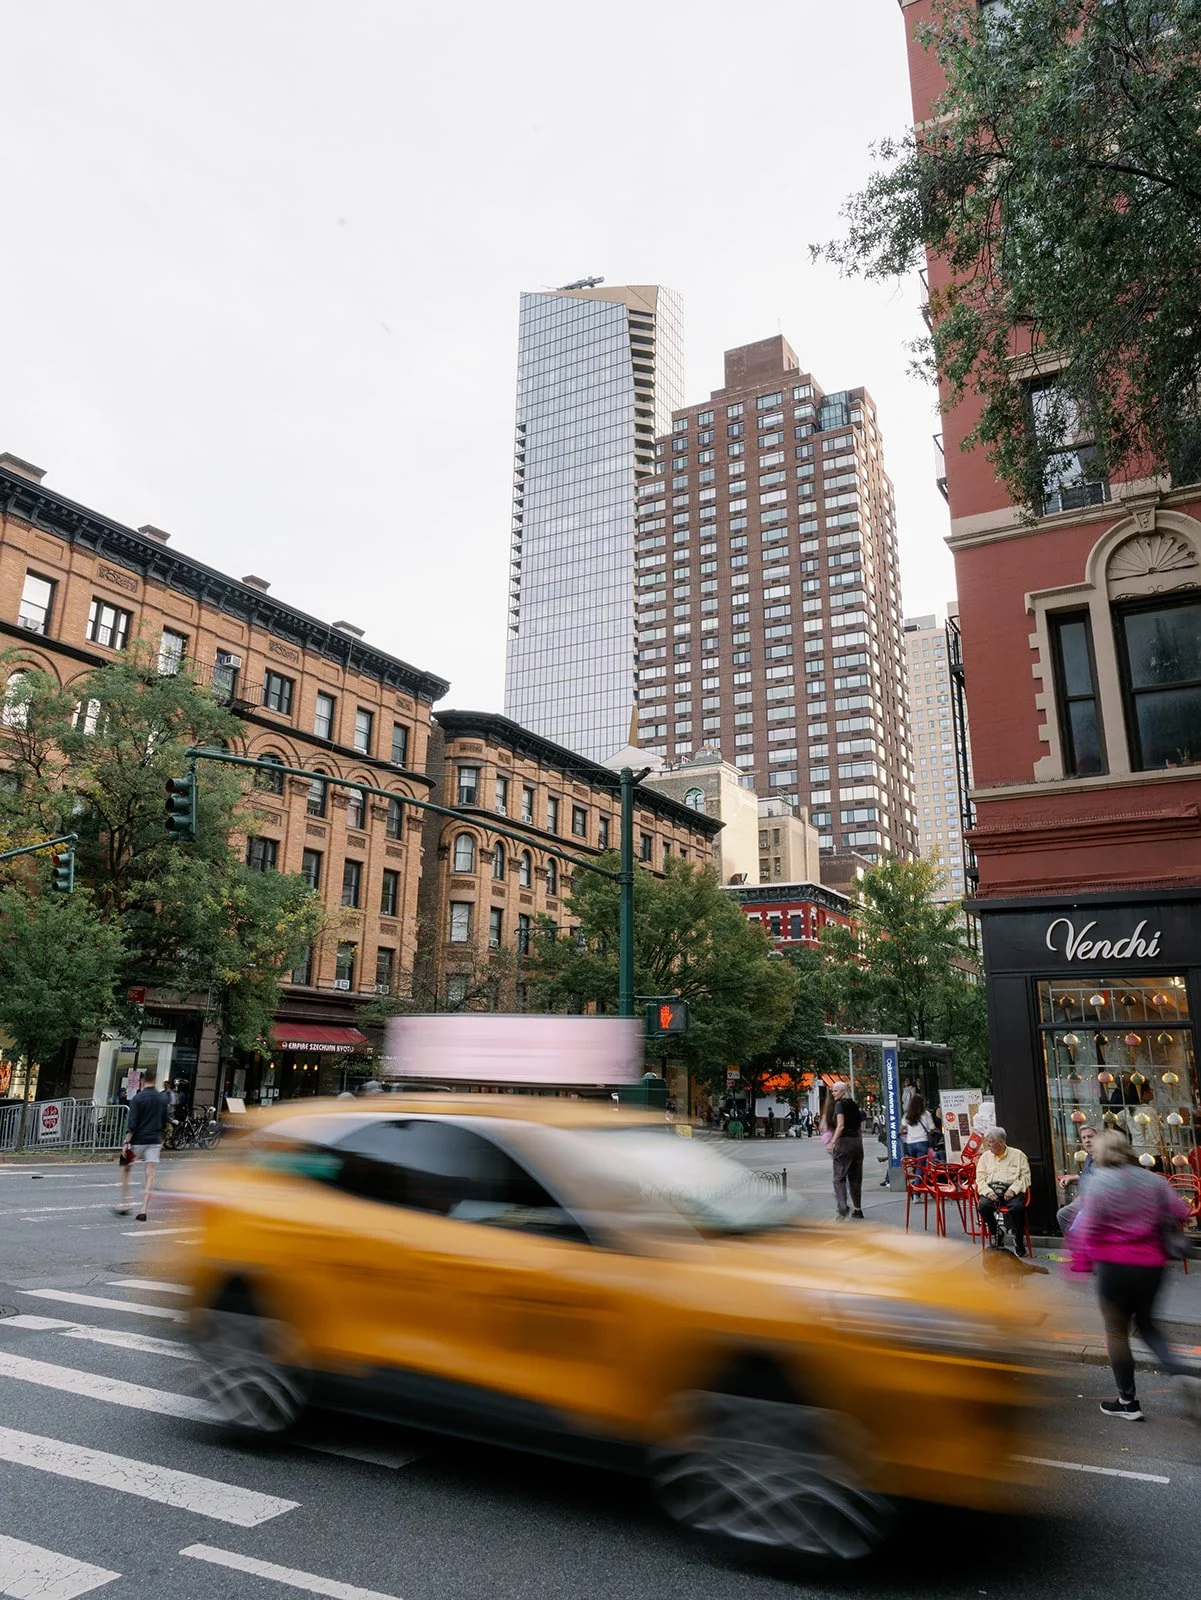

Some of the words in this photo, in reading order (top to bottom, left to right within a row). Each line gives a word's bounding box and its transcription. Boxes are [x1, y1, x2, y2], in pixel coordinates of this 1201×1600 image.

[1046, 918, 1161, 961] Venchi
[288, 1042, 308, 1050] EMPIRE
[309, 1043, 335, 1052] SZECHUAN
[890, 1122, 896, 1130] W
